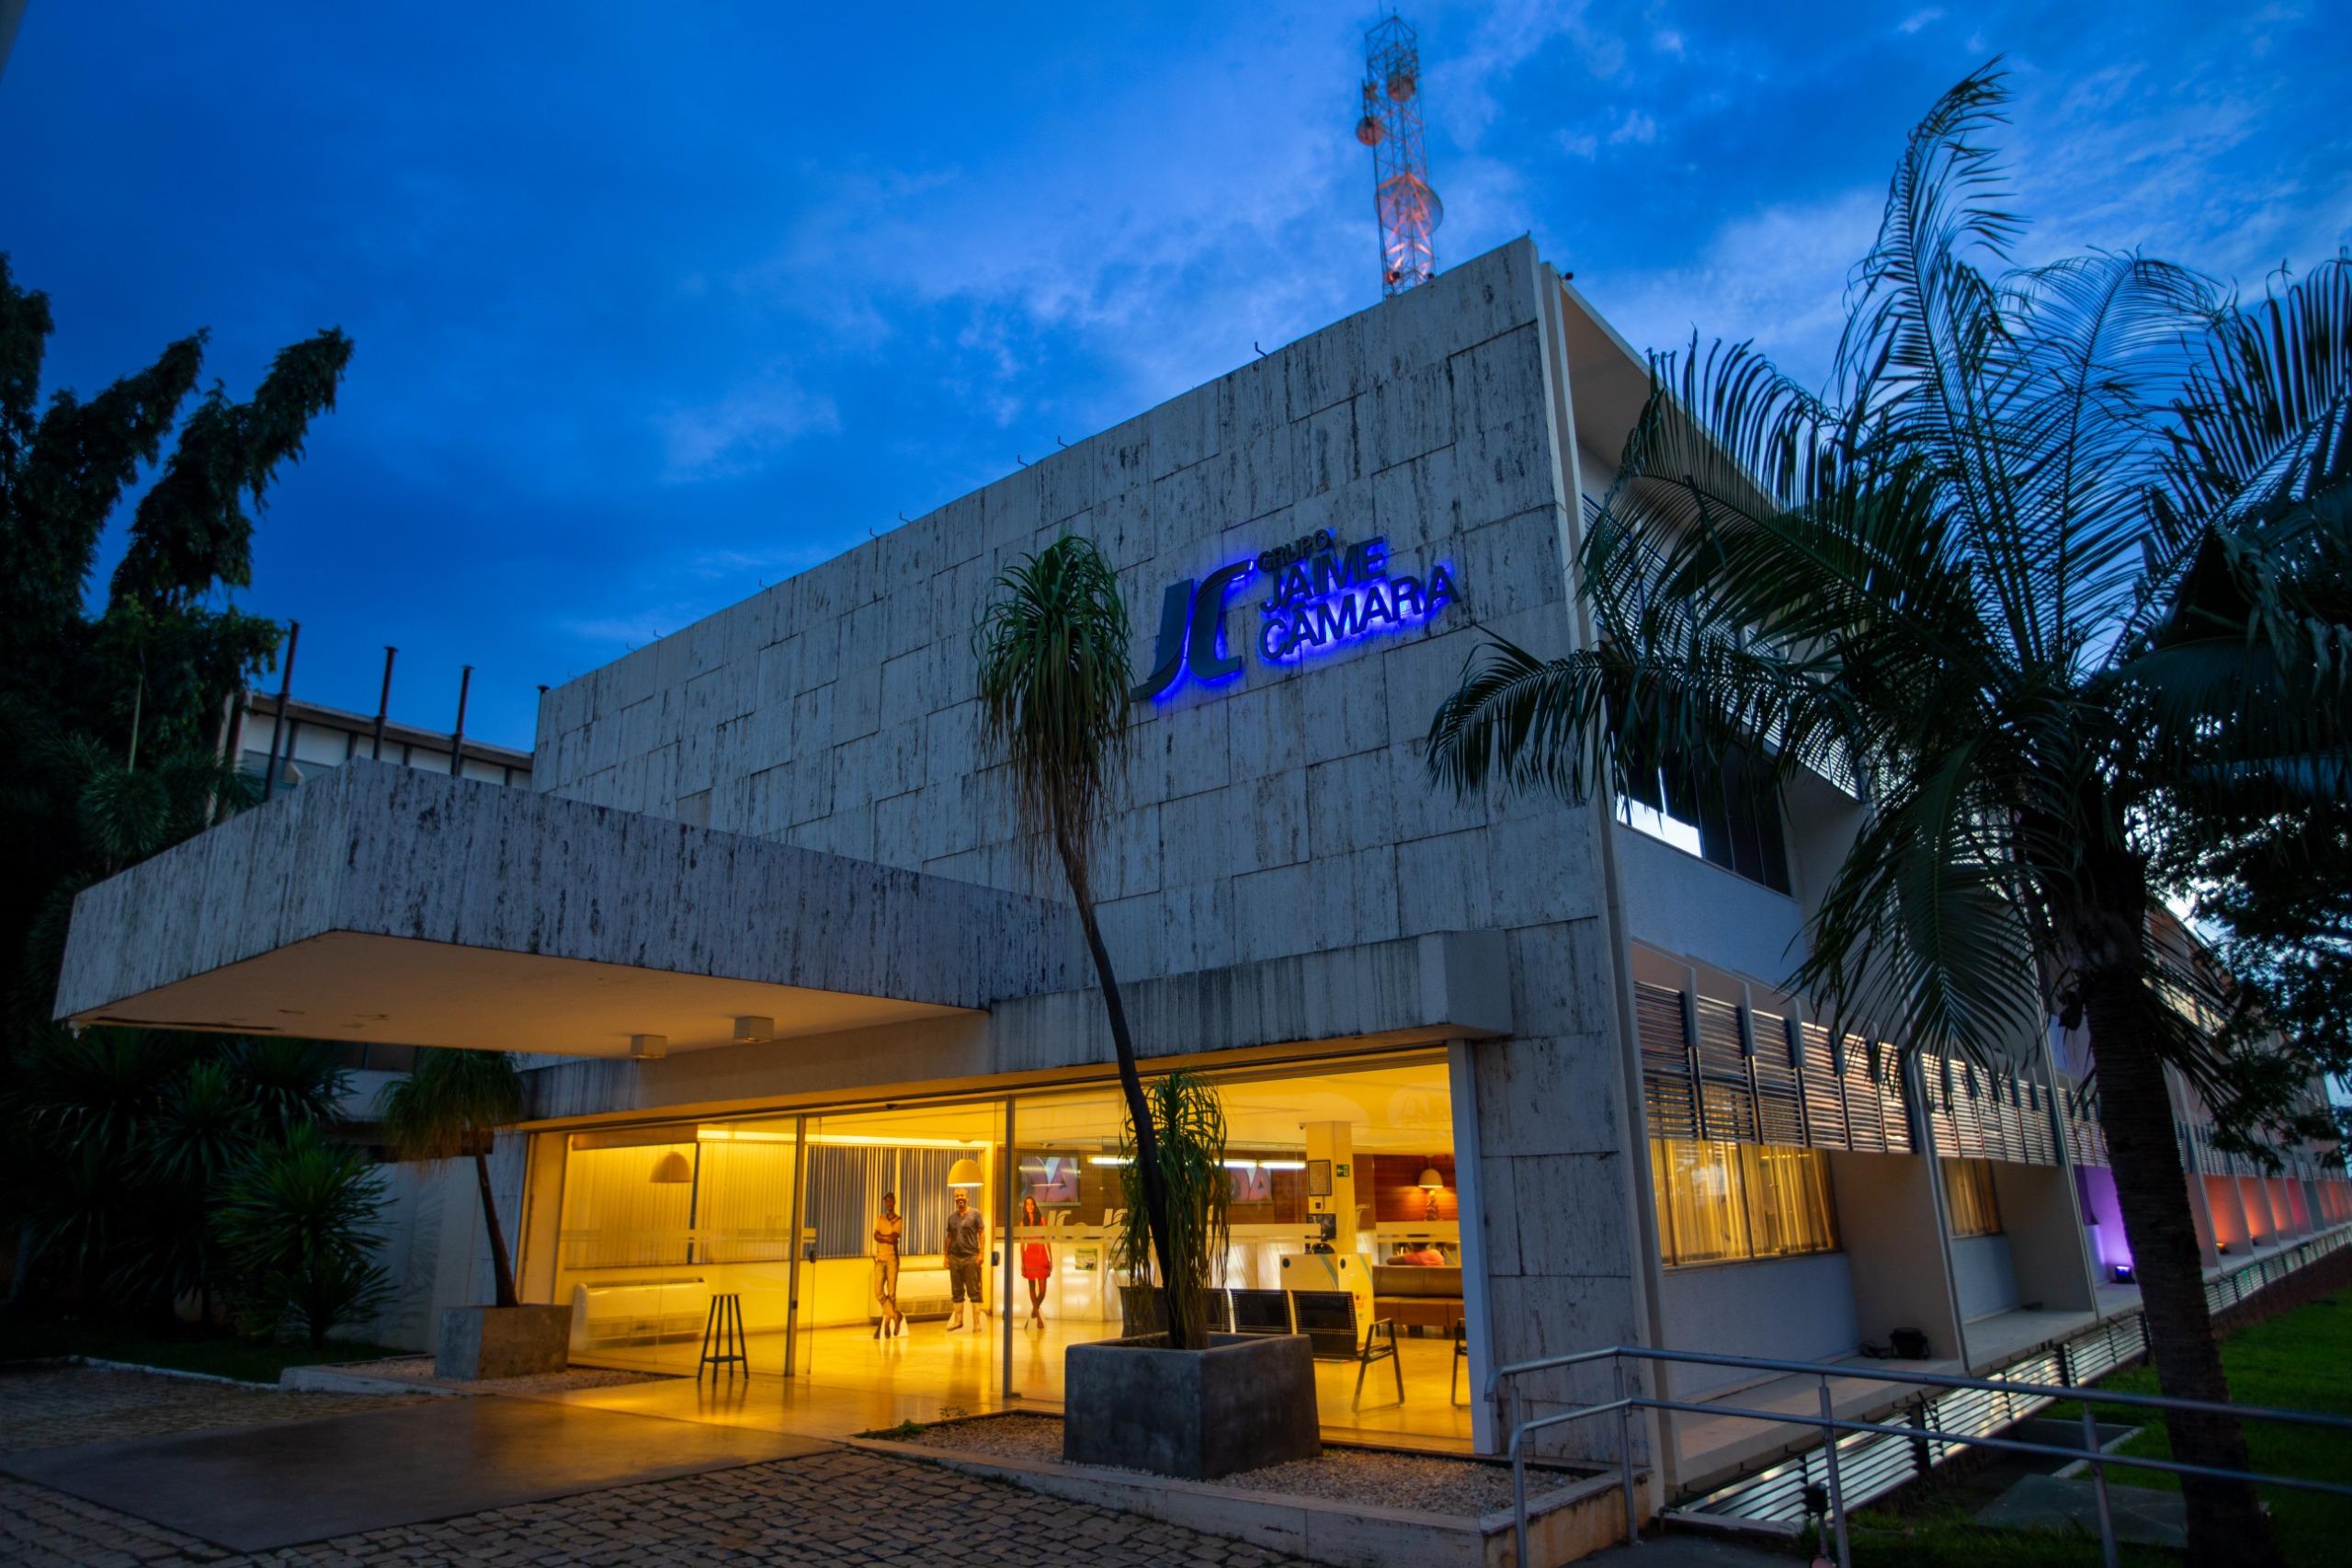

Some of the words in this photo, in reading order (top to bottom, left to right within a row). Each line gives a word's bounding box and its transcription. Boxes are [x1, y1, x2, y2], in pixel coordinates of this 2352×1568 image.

[1257, 529, 1330, 573] GRUPO
[1259, 536, 1386, 612] JAIME
[1260, 565, 1461, 660] CÂMARA
